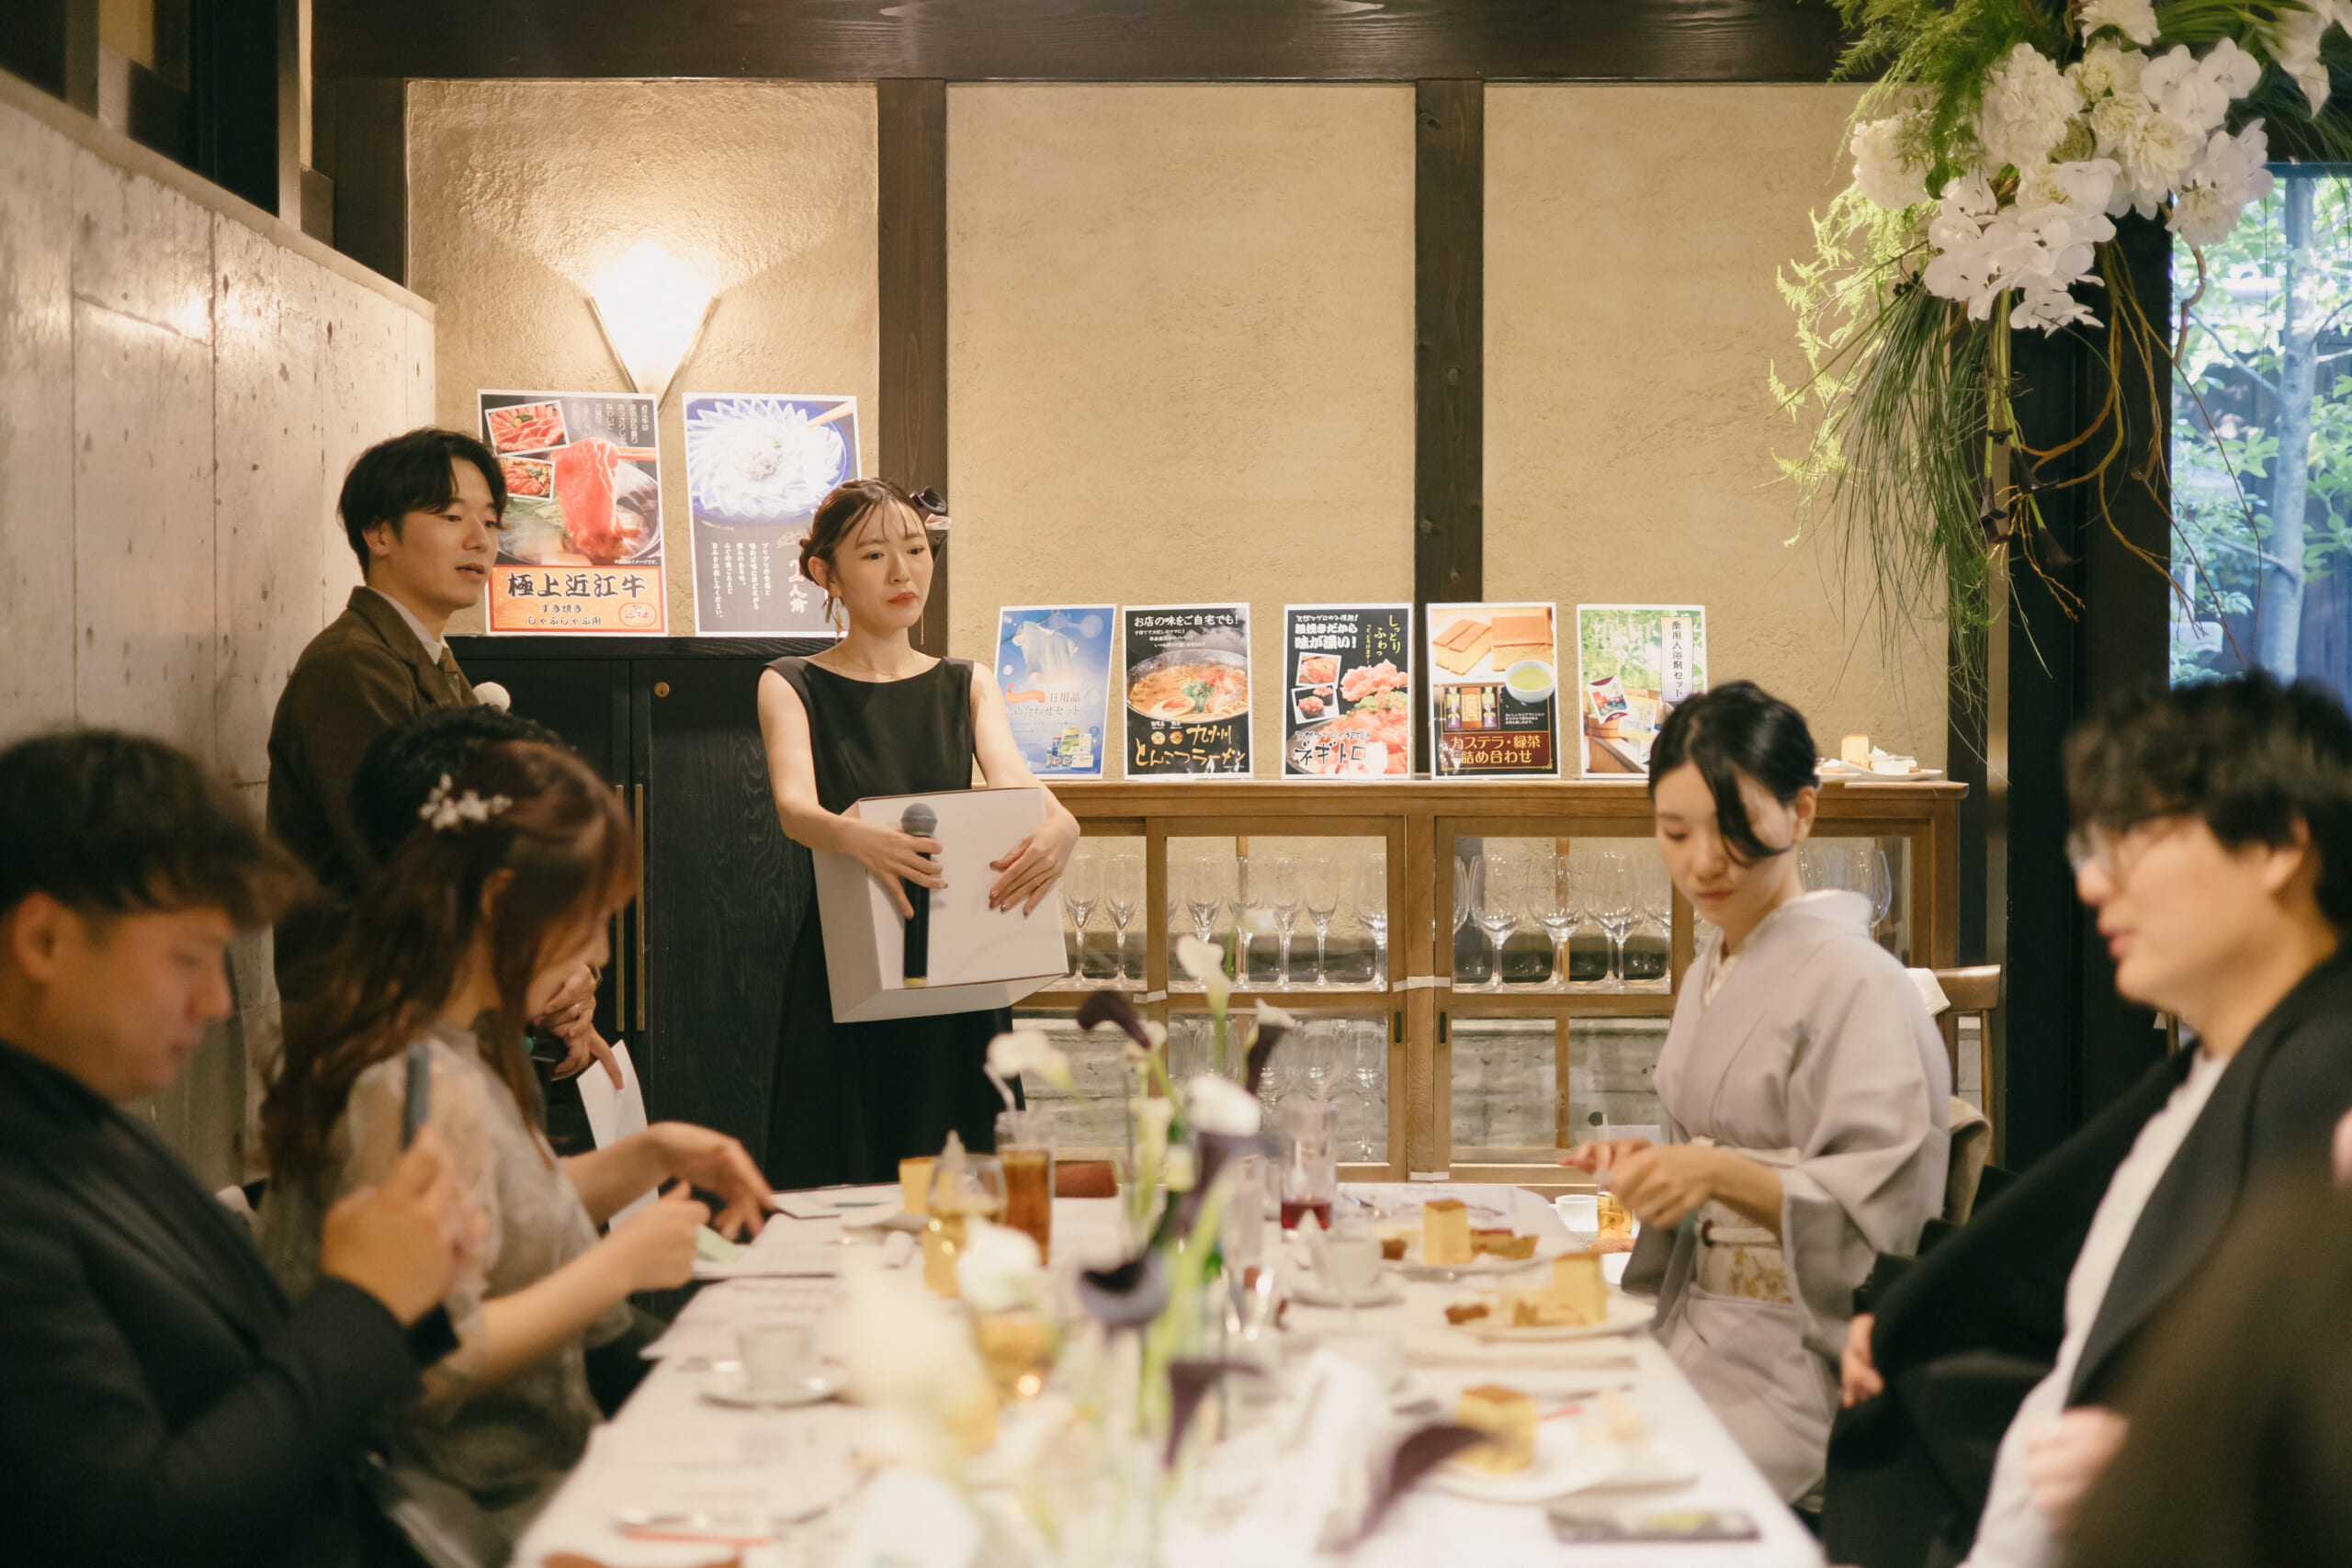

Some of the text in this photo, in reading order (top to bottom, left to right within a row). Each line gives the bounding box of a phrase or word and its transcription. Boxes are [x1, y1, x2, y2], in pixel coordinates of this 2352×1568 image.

[507, 572, 647, 599] 極上近江牛
[541, 604, 582, 614] すき焼き
[528, 616, 603, 626] しゃぶしゃぶ用
[1134, 614, 1239, 627] お店の味をご自宅でも！
[1374, 626, 1388, 657] ふわっ
[1388, 614, 1401, 655] しっとり
[1671, 620, 1683, 698] 薬用入浴剤セット
[1050, 691, 1080, 704] 日用品
[1186, 724, 1233, 746] 九州
[1451, 735, 1541, 750] カステラ・緑茶
[1135, 738, 1246, 767] とんこつラーメン
[1294, 740, 1367, 766] ネギトロ
[1461, 750, 1533, 765] 詰め合わせ
